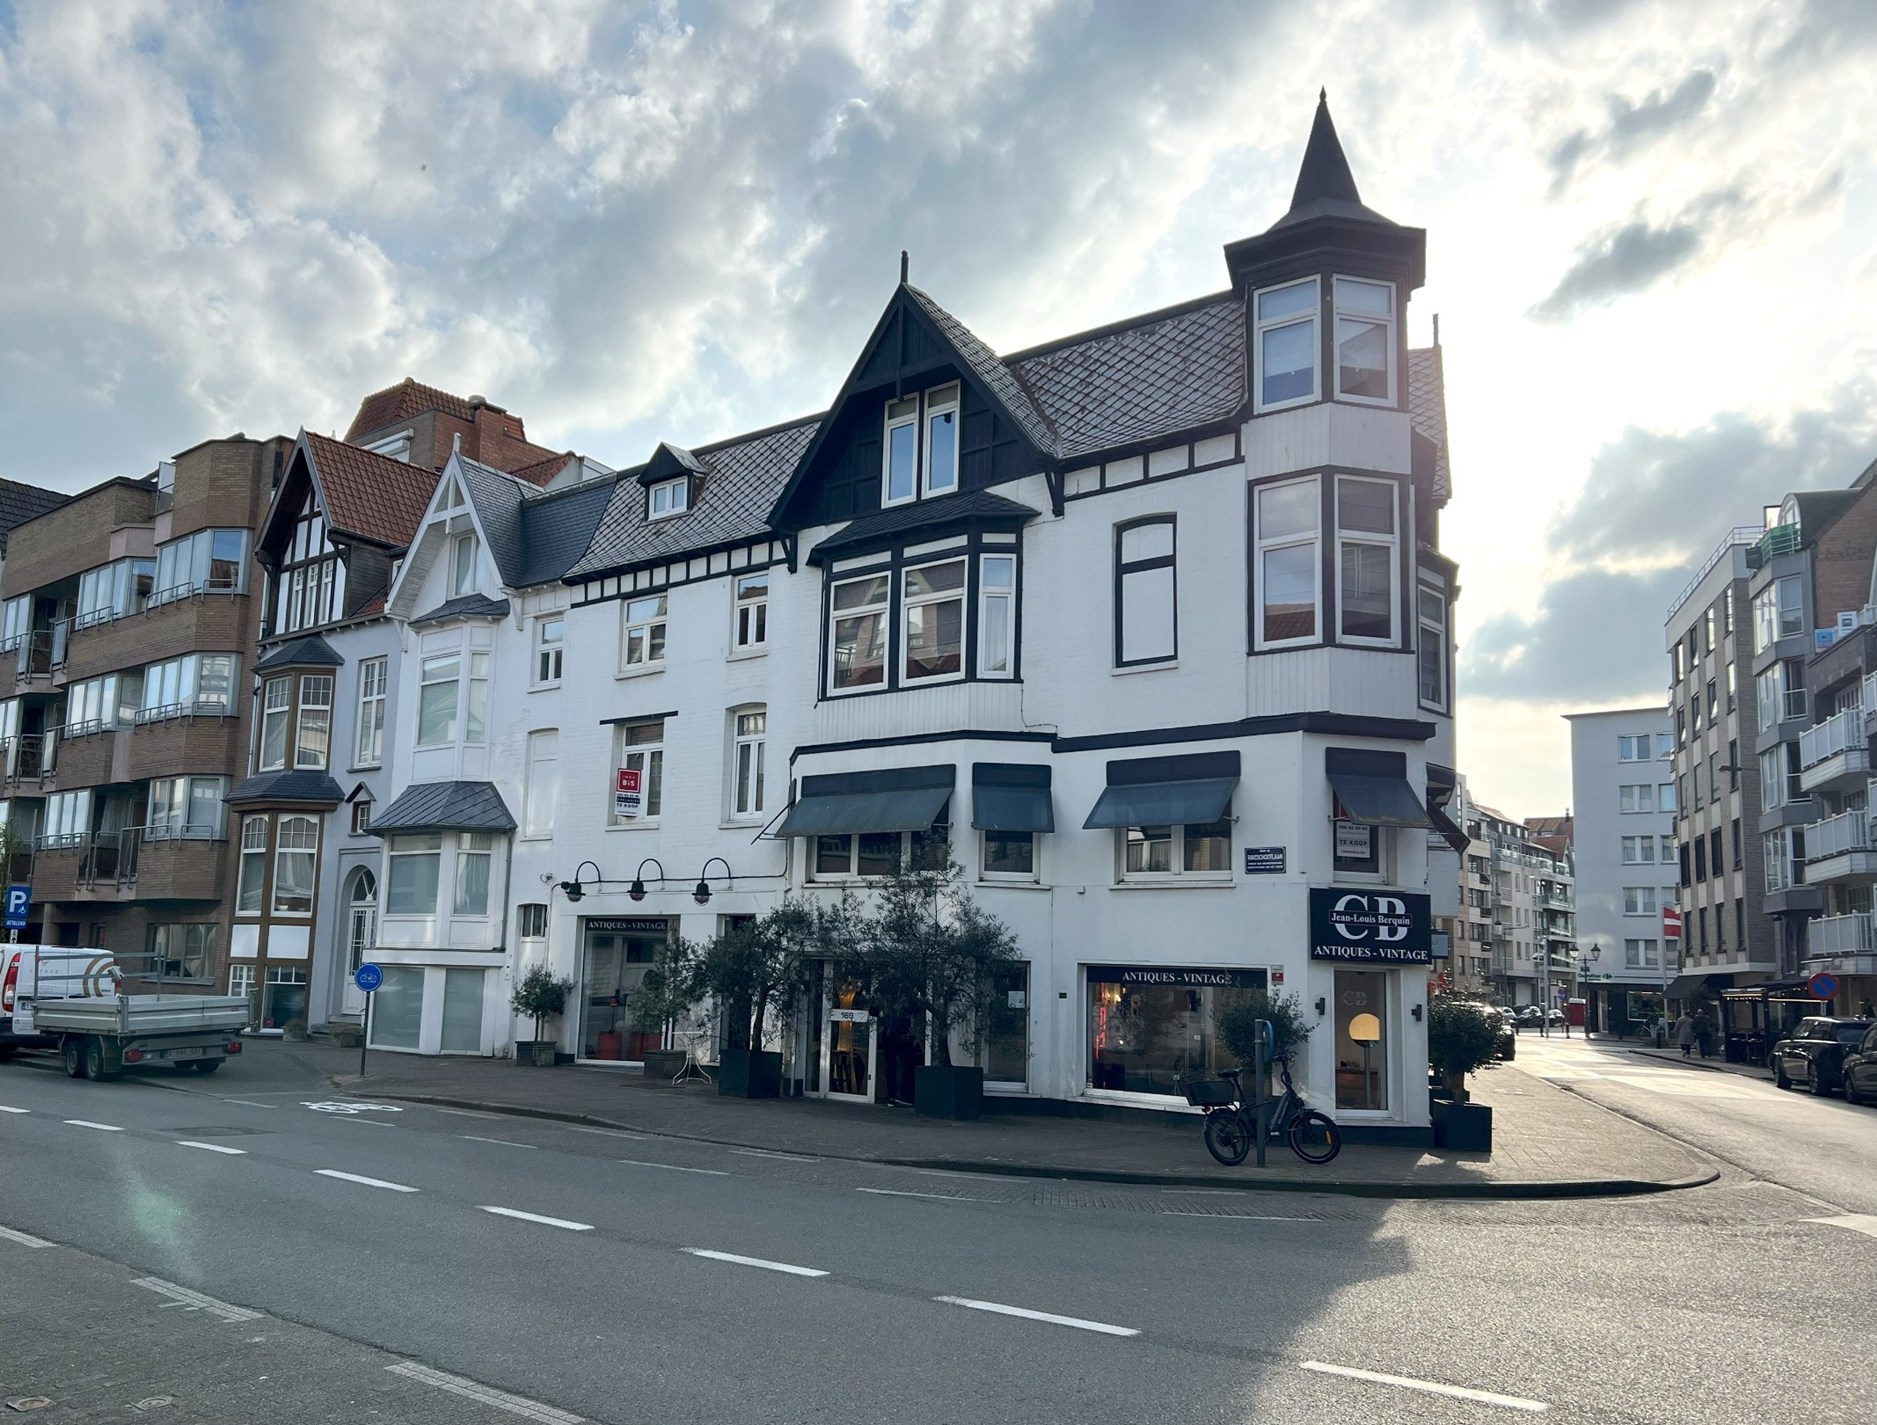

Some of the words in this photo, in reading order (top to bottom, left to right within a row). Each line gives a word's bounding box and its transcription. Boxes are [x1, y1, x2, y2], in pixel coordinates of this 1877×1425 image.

[9, 890, 27, 913] P
[588, 921, 627, 930] ANTIQUES
[631, 922, 666, 930] VINTAGE
[1331, 912, 1376, 924] Jean-Louis
[1378, 915, 1410, 927] Berquin
[1314, 945, 1371, 958] ANTIQUES
[1379, 948, 1429, 960] VINTAGE
[1123, 972, 1176, 983] ANTIQUES
[1183, 973, 1232, 985] VINTAGE
